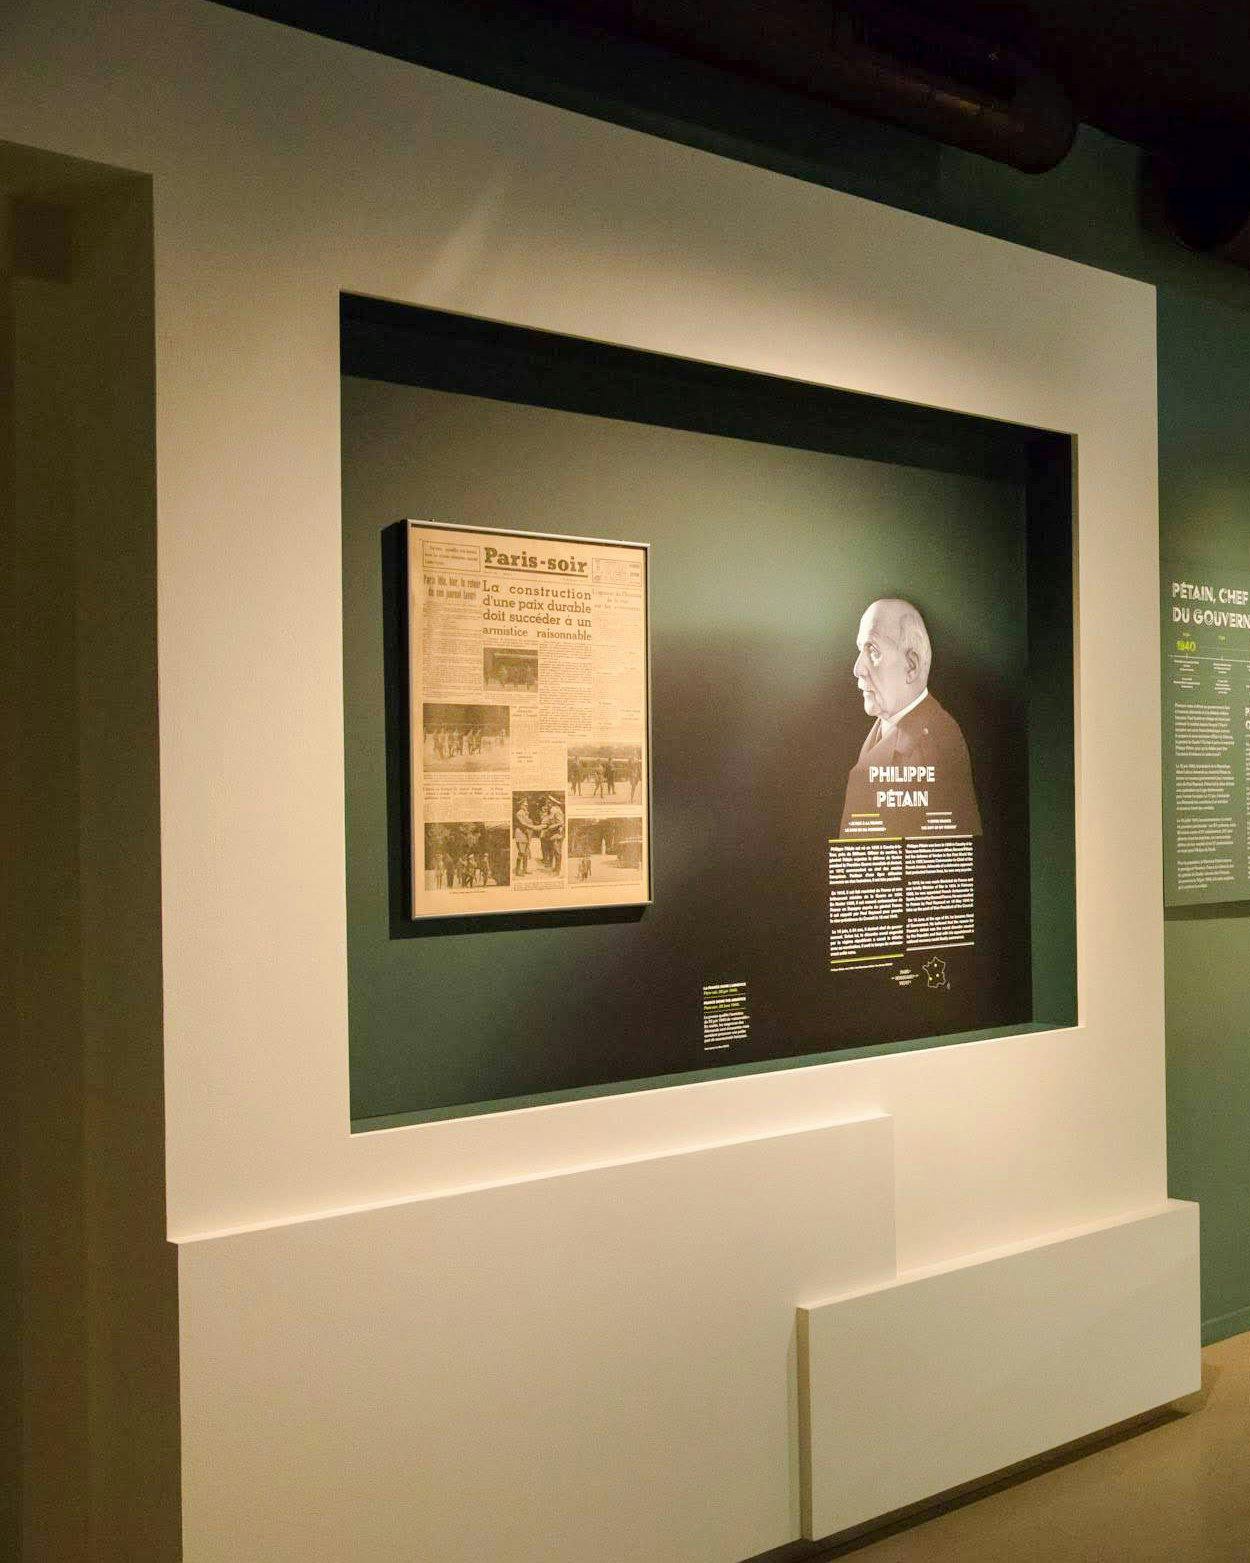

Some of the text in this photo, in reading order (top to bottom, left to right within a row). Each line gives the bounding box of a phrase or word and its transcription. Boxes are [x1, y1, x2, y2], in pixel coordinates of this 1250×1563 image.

[485, 547, 588, 573] Paris-soir
[482, 580, 500, 592] La
[509, 586, 591, 600] construction
[1172, 582, 1249, 605] PÉTAIN, CHEF
[483, 595, 516, 608] d'une
[519, 599, 544, 611] paix
[547, 600, 591, 613] durable
[483, 610, 592, 627] doit succéder à un
[1173, 607, 1190, 623] DU
[482, 625, 592, 641] armistice raisonnable
[869, 766, 935, 783] PHILIPPE
[876, 788, 929, 807] PÉTAIN
